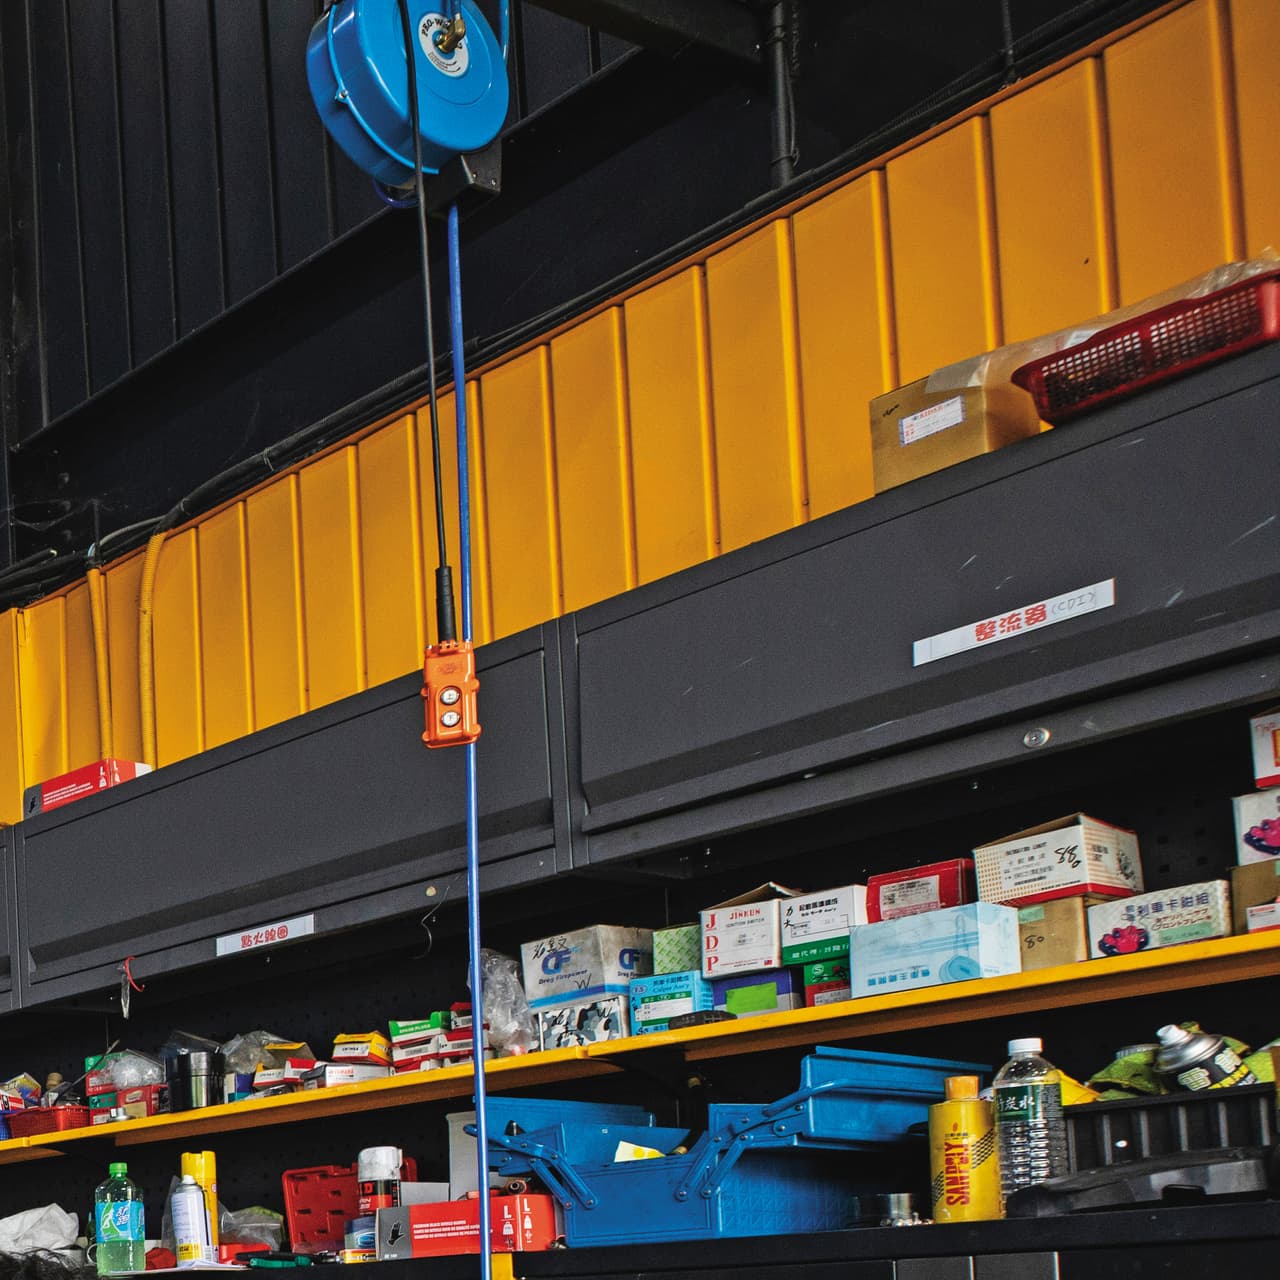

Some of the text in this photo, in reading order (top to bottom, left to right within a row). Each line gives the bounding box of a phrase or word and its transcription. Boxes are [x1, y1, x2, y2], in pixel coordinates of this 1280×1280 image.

[975, 603, 1047, 642] 整流器
[705, 914, 716, 929] J
[705, 936, 719, 950] D
[707, 956, 719, 971] P
[524, 1198, 531, 1211] L
[503, 1205, 512, 1219] L
